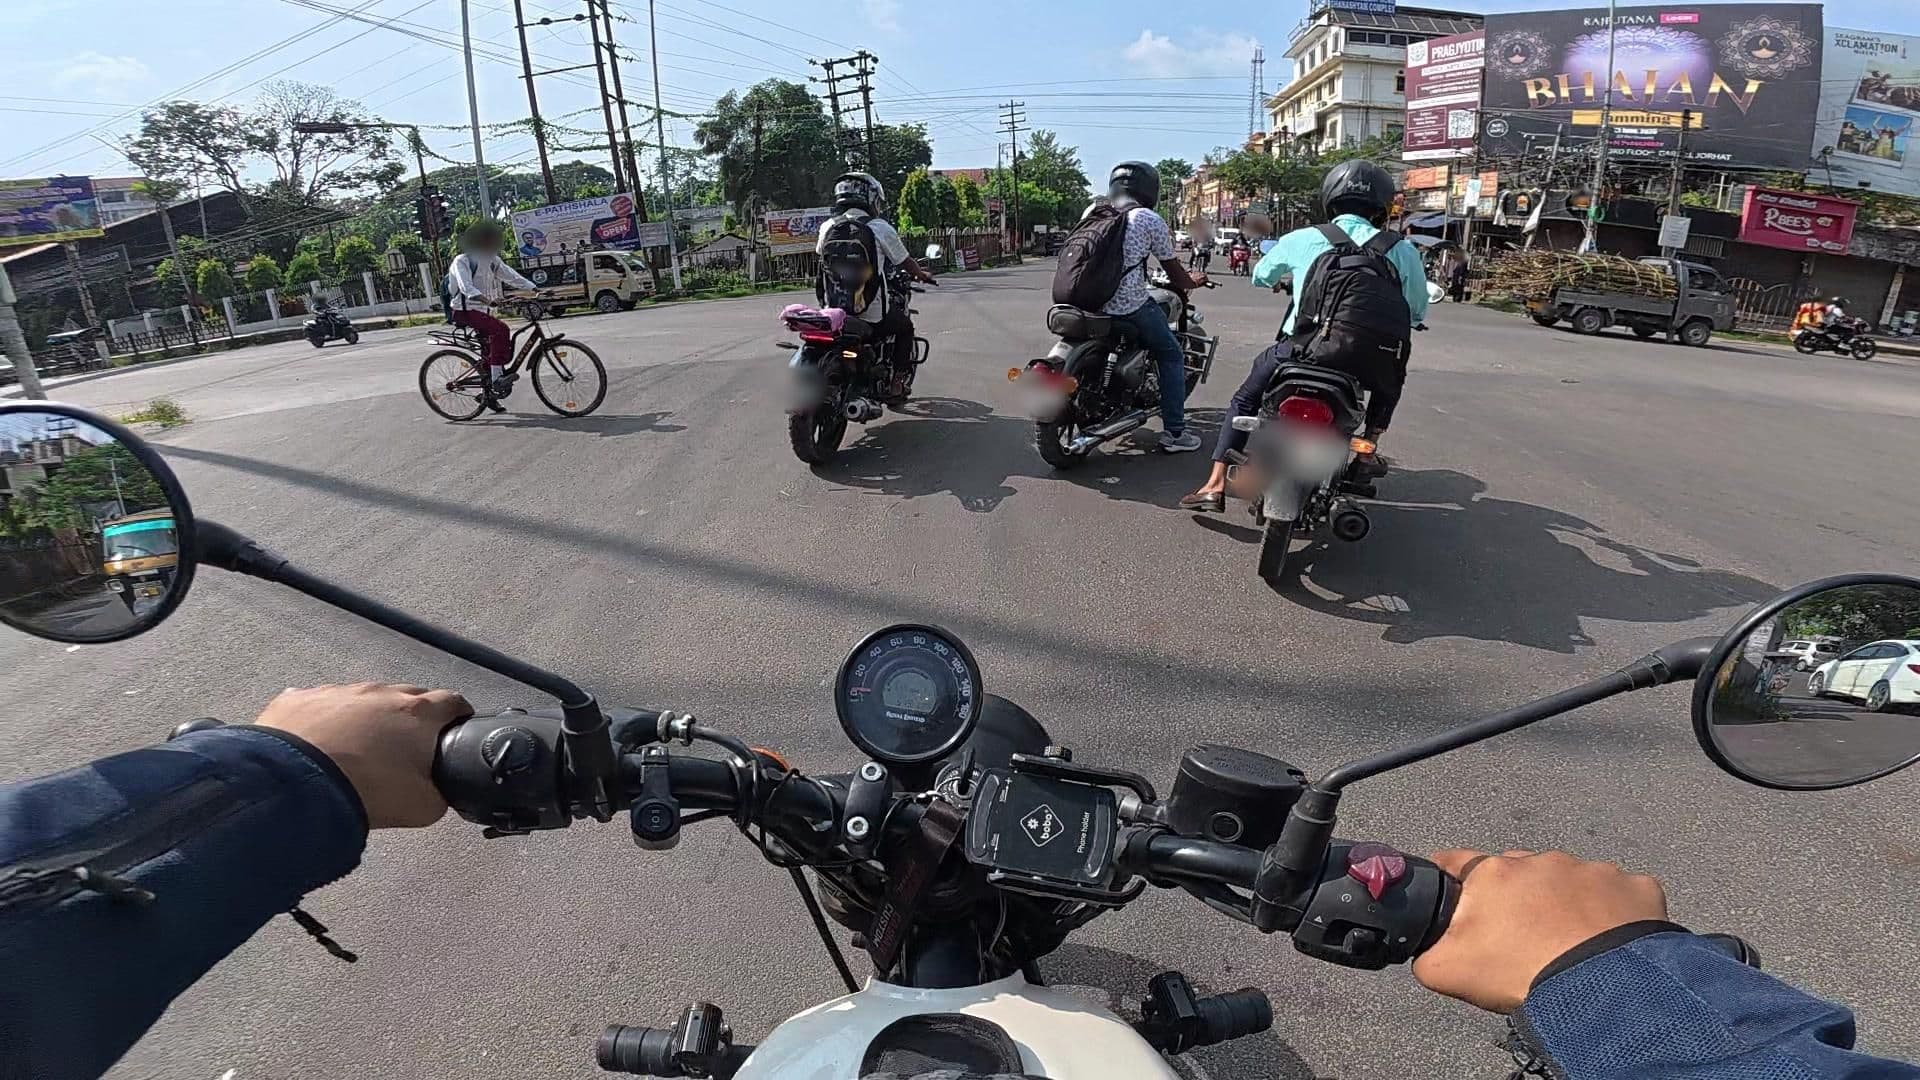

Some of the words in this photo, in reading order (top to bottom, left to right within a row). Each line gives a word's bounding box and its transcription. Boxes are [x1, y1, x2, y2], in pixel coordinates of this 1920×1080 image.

[1522, 69, 1767, 114] BHAJAN
[534, 197, 608, 217] E-PATHSHALA
[603, 224, 627, 237] OPEN
[890, 637, 903, 647] 60
[913, 636, 926, 645] 80
[933, 642, 949, 656] 100
[870, 646, 882, 658] 40
[855, 663, 866, 677] 20
[951, 657, 964, 674] 120
[960, 678, 971, 697] 140
[1040, 813, 1053, 839] bobo
[1081, 812, 1091, 832] holder
[1077, 833, 1087, 853] Phone
